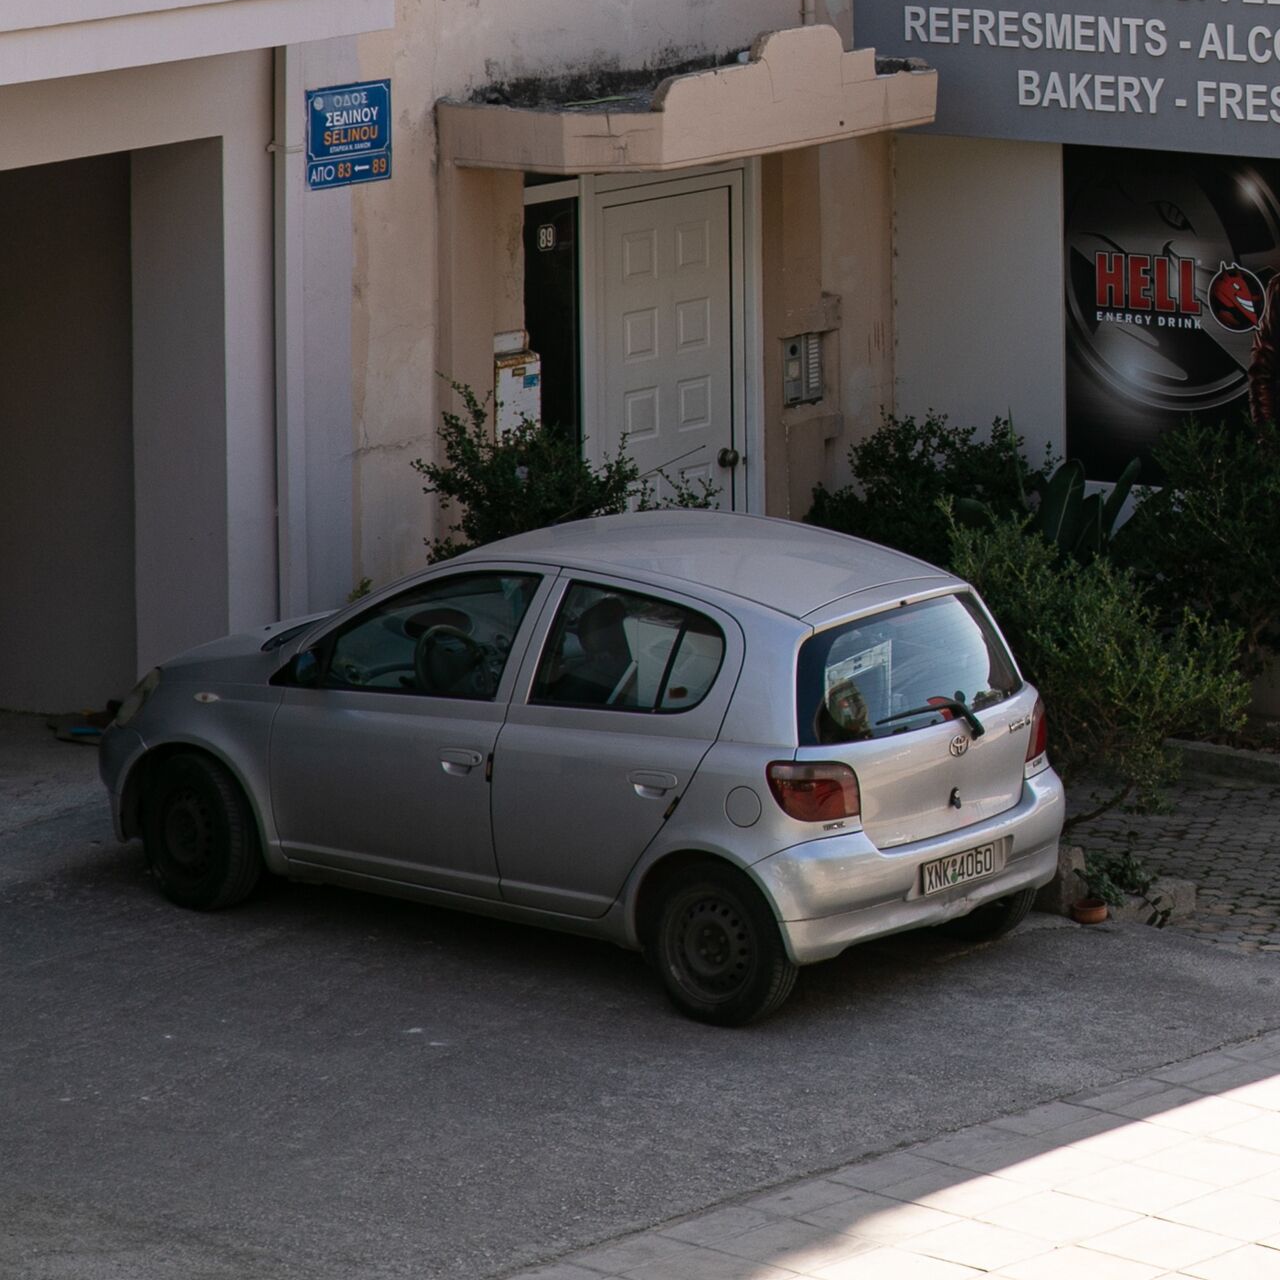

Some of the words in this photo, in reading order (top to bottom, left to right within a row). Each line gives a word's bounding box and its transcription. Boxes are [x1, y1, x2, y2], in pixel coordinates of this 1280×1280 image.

[904, 5, 1167, 57] REFRESMENTS
[333, 92, 367, 107] ΟΔΟΣ
[1017, 70, 1163, 116] BAKERY
[325, 107, 378, 126] ΣΕΛΙΝΟΥ
[324, 125, 378, 145] SELINOU
[311, 166, 335, 182] ΑΠΟ
[338, 163, 351, 177] 83
[372, 158, 386, 174] 89
[539, 227, 554, 248] 89
[1096, 252, 1201, 314] HELL
[1096, 312, 1151, 326] ENERGY
[1158, 316, 1201, 329] DRINK
